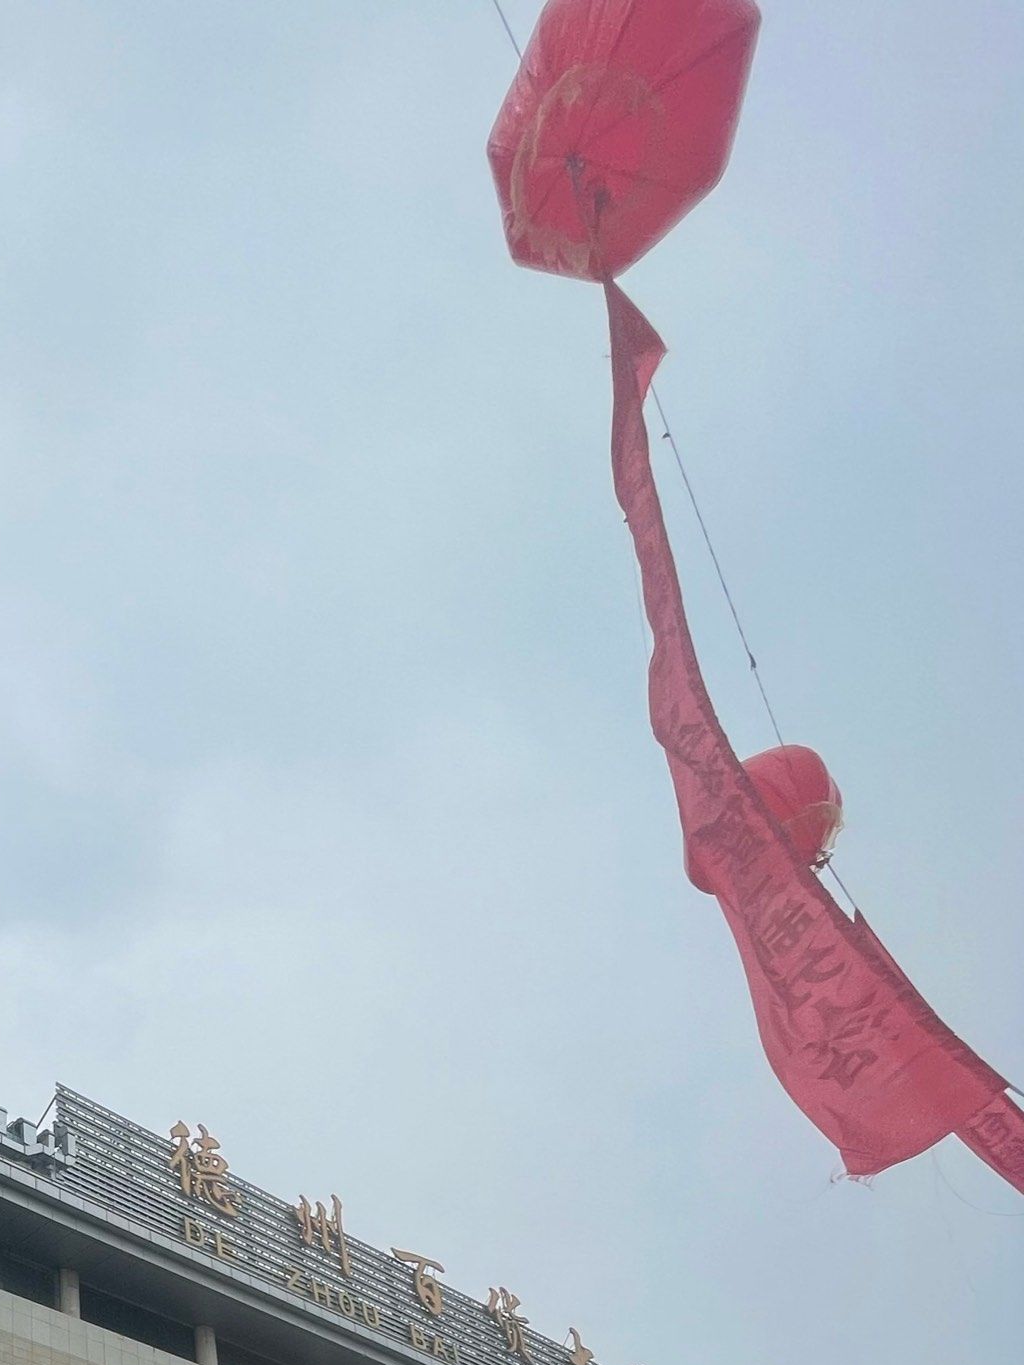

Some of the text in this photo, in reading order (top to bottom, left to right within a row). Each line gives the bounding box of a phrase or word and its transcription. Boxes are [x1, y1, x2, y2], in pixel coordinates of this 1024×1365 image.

[183, 1215, 234, 1261] DE
[285, 1264, 381, 1329] ZHOU
[409, 1323, 461, 1365] BAI
